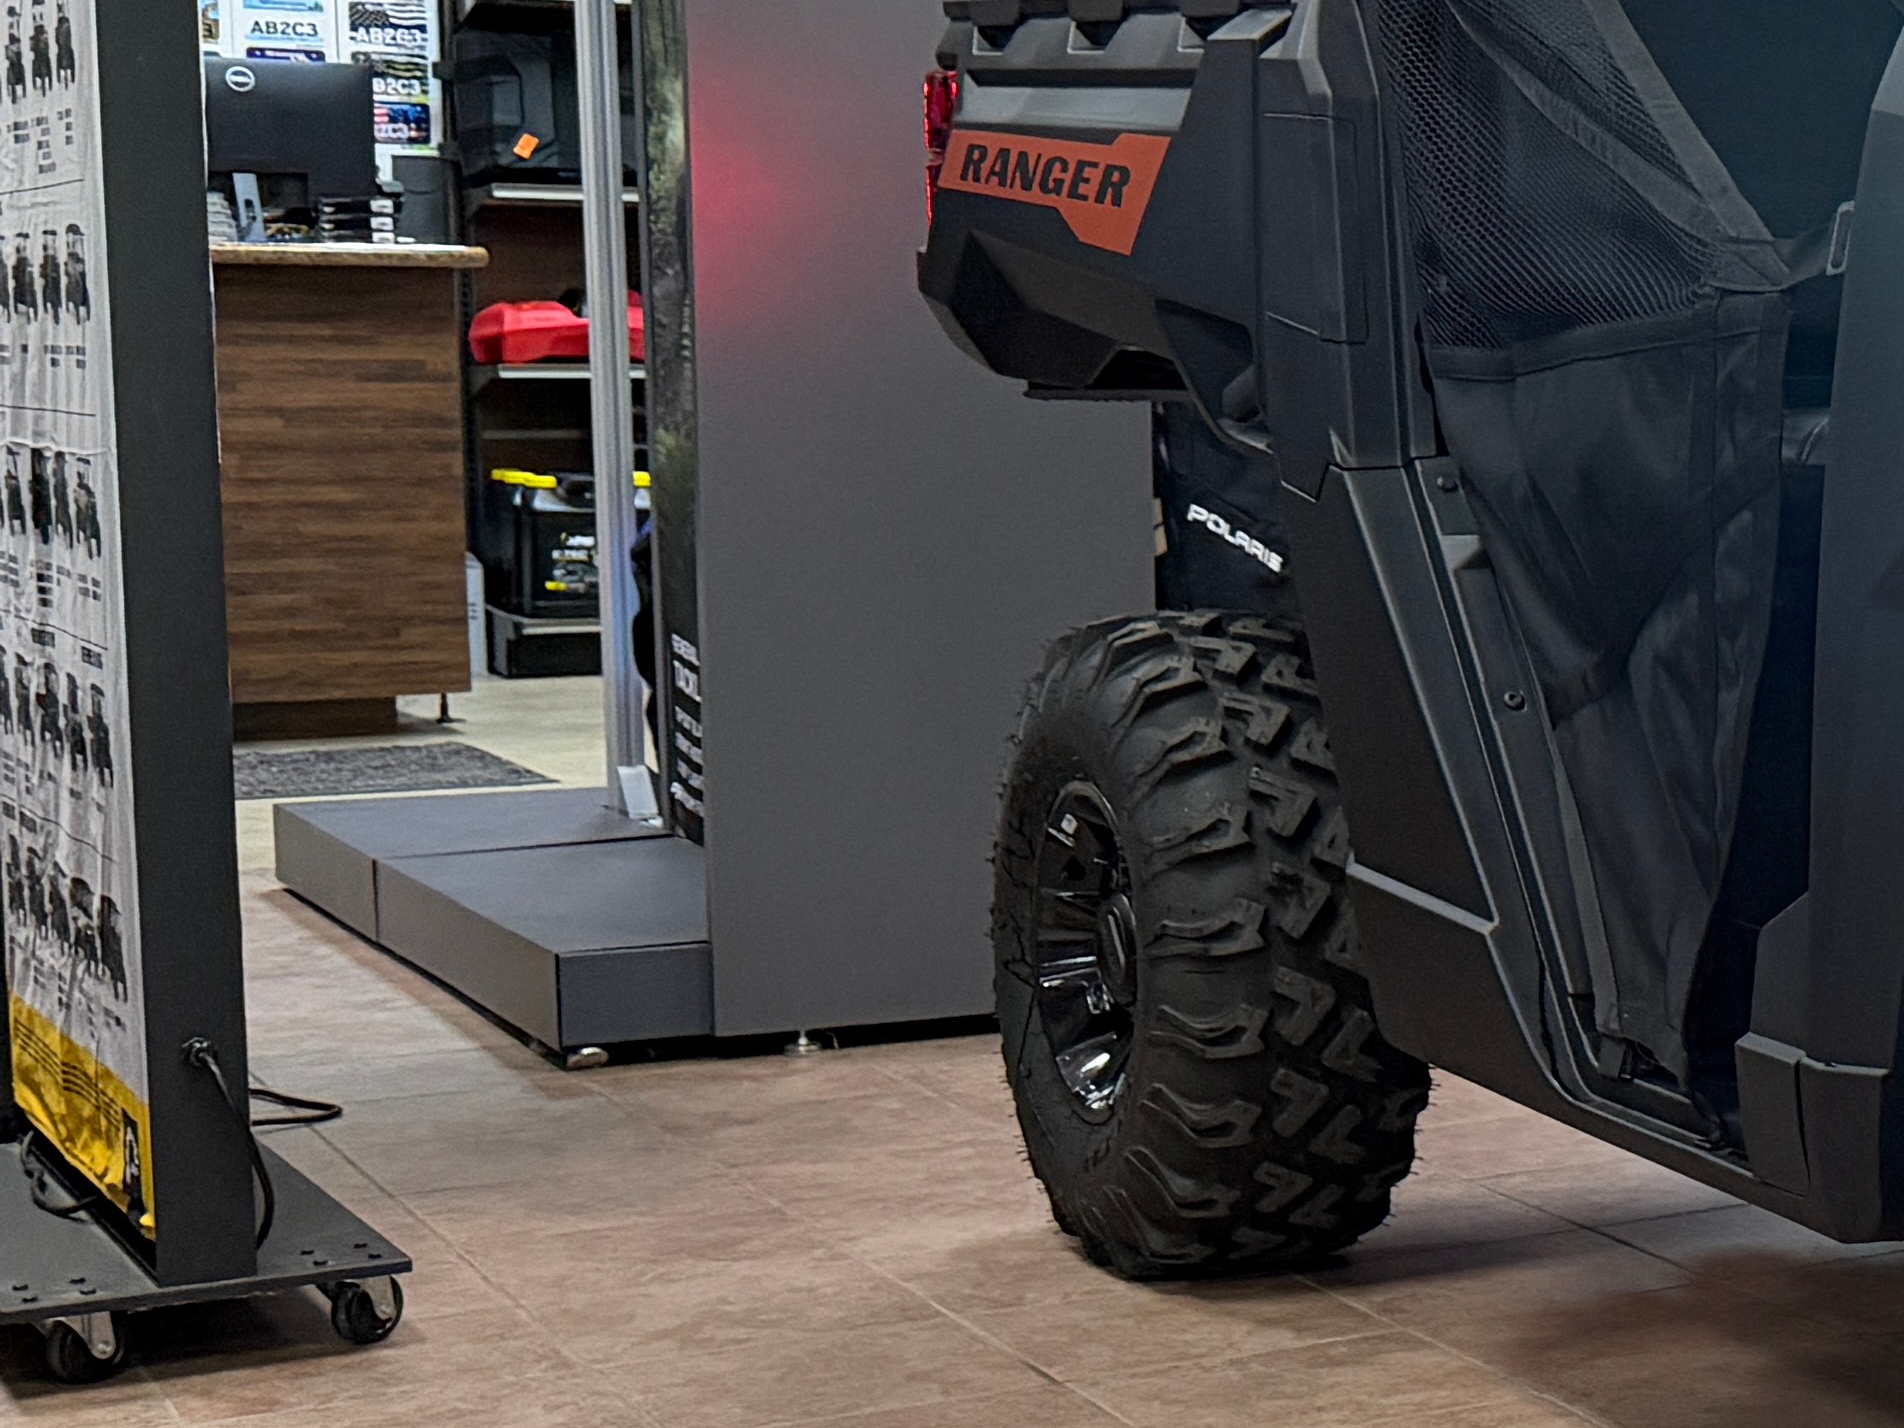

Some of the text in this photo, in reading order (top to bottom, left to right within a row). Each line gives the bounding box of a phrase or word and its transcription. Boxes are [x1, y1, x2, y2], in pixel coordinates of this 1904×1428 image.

[250, 20, 319, 38] AB2C3
[372, 77, 422, 95] B2C3
[959, 142, 1131, 209] RANGER
[1187, 502, 1284, 574] POLARIS
